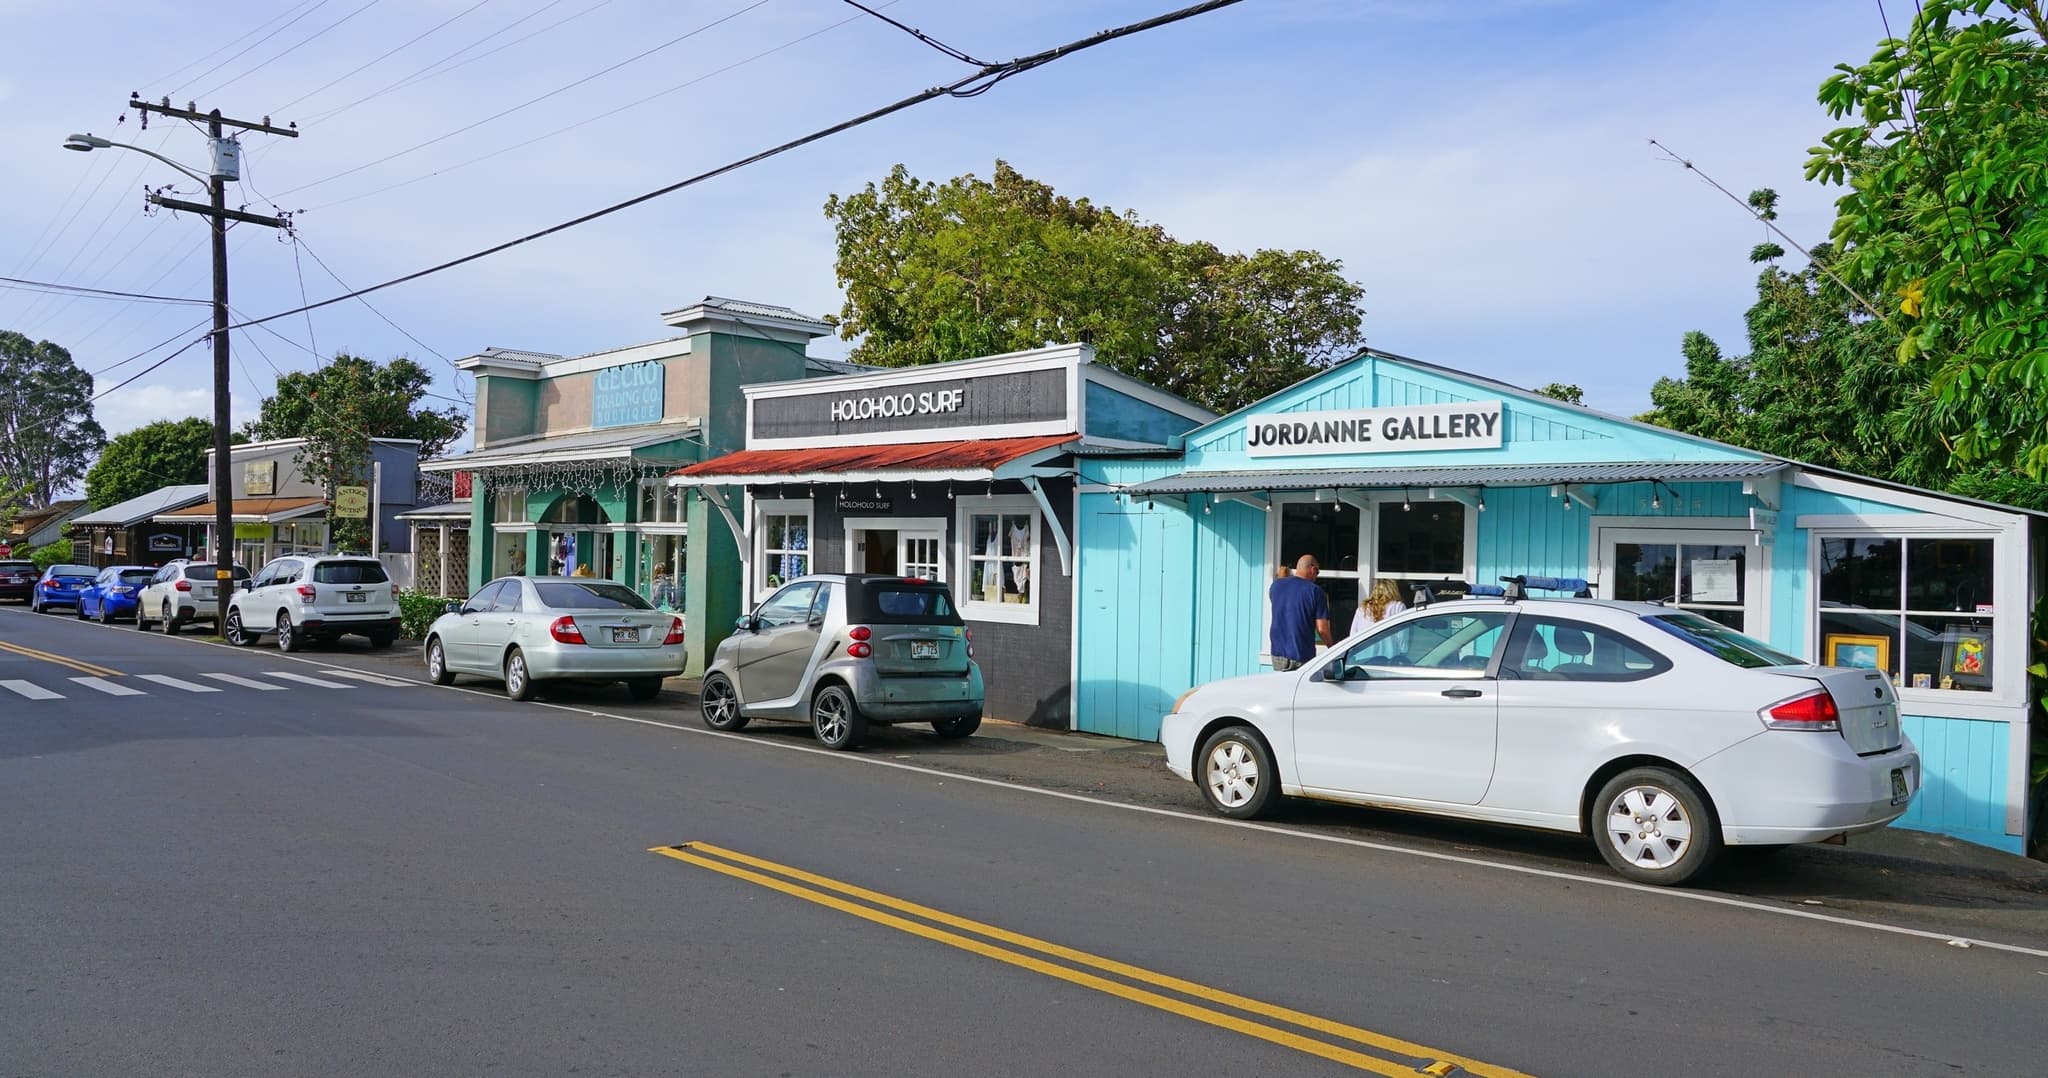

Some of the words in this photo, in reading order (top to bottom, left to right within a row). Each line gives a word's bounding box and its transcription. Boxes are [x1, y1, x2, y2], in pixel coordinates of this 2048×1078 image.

[597, 360, 659, 390] GECKO
[596, 390, 640, 409] TRADING
[831, 393, 916, 421] HOLOHOLO
[918, 389, 964, 414] SURF
[597, 405, 656, 423] BOUTIQUE
[1248, 418, 1372, 447] JORDANNE
[1382, 412, 1499, 441] GALLERY
[337, 489, 367, 498] ANTIQUE
[839, 501, 875, 509] HOLOHOLO
[875, 502, 891, 510] SURF
